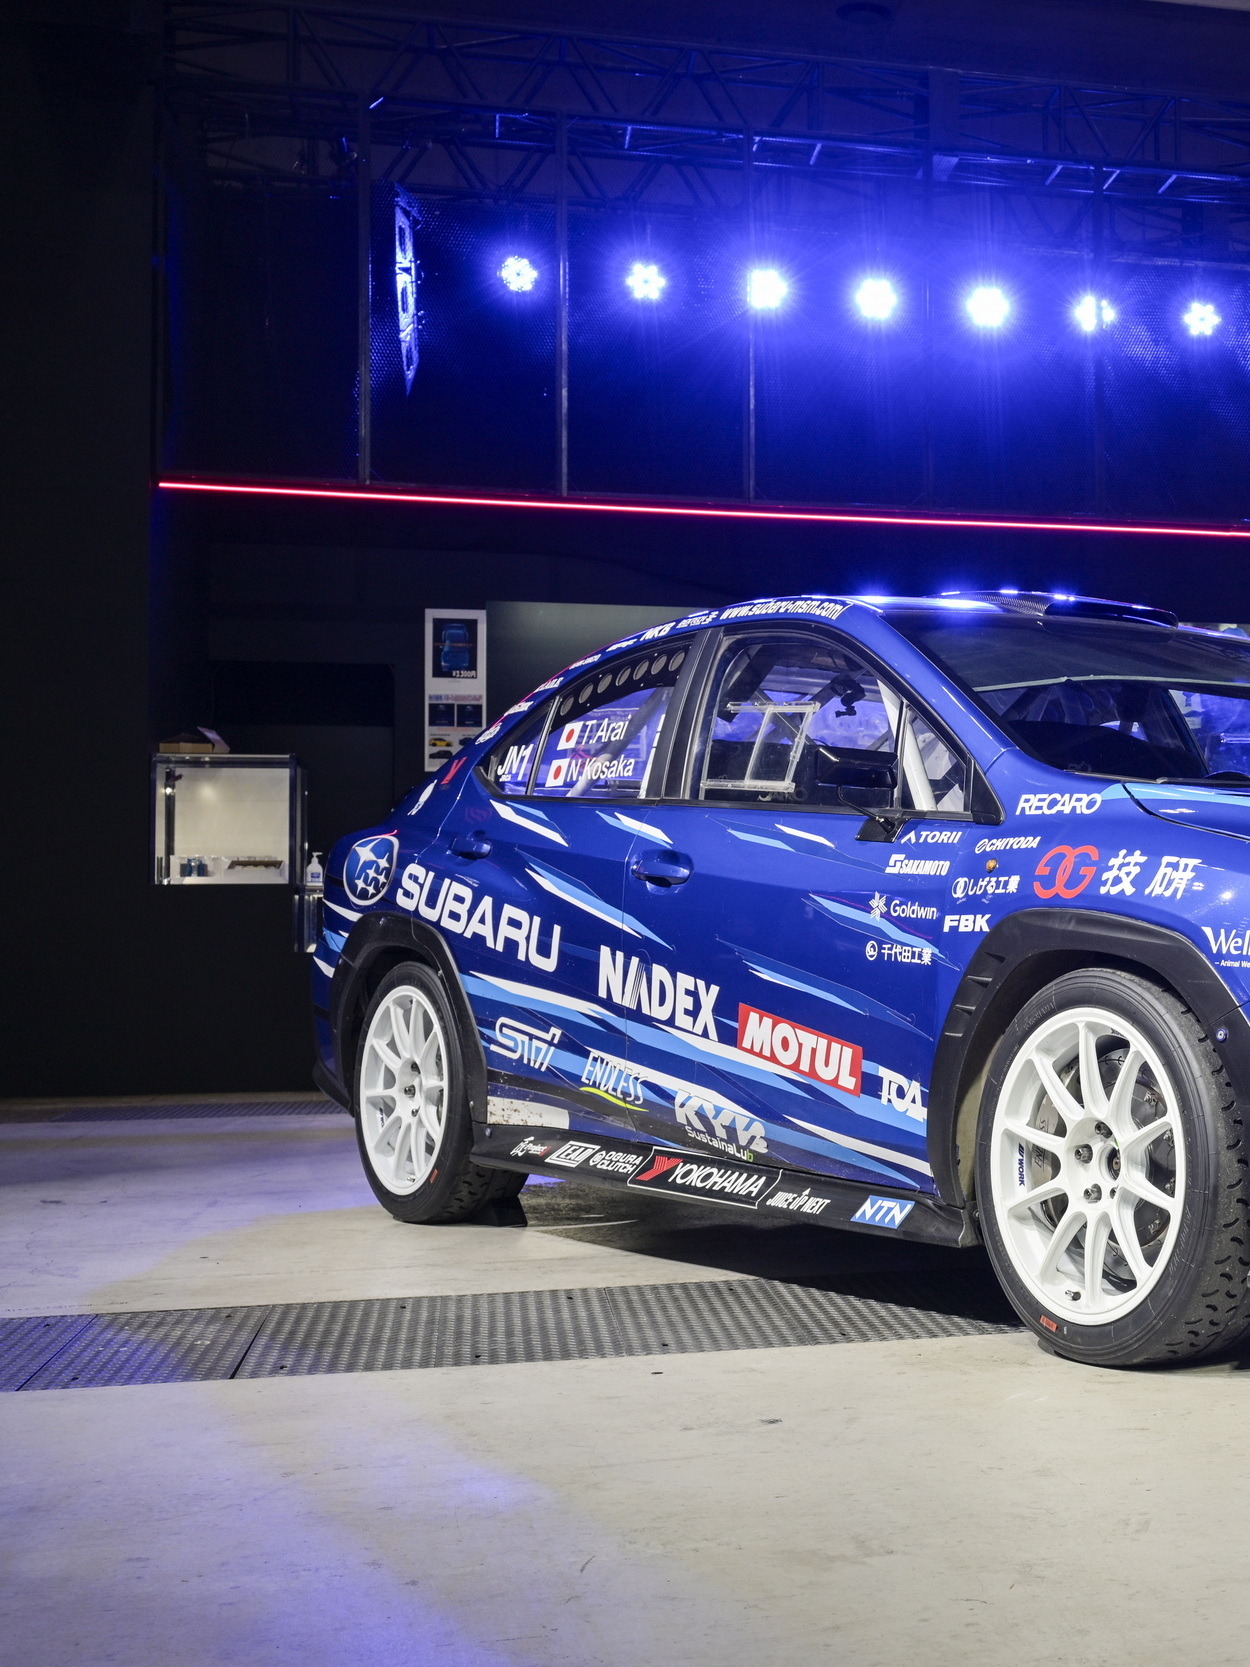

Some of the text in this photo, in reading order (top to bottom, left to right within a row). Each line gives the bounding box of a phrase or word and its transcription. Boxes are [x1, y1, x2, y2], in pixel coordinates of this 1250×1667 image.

[582, 714, 632, 746] T.Arai
[497, 744, 534, 781] JN1
[567, 755, 635, 782] N.Kosaka
[1016, 793, 1101, 815] RECARO
[919, 831, 962, 844] TORII
[985, 836, 1041, 851] CHIYODA
[900, 859, 950, 876] SAKAMOTO
[968, 875, 1021, 895] しげる工業
[396, 863, 562, 973] SUBARU
[890, 900, 938, 920] Goldwin
[943, 914, 991, 933] FBK
[881, 943, 933, 966] 千代田工業
[598, 944, 720, 1042] NADEX
[742, 1010, 857, 1090] MOTUL
[581, 1051, 650, 1105] ENDLESS
[674, 1088, 768, 1154] KYB
[685, 1125, 755, 1163] SustainaLub
[596, 1160, 637, 1174] CLUTCH
[604, 1151, 643, 1165] OGURA
[668, 1162, 767, 1197] YOKOHAMA
[766, 1191, 798, 1208] JUICE
[800, 1196, 831, 1214] NEXT
[855, 1198, 913, 1228] NTN
